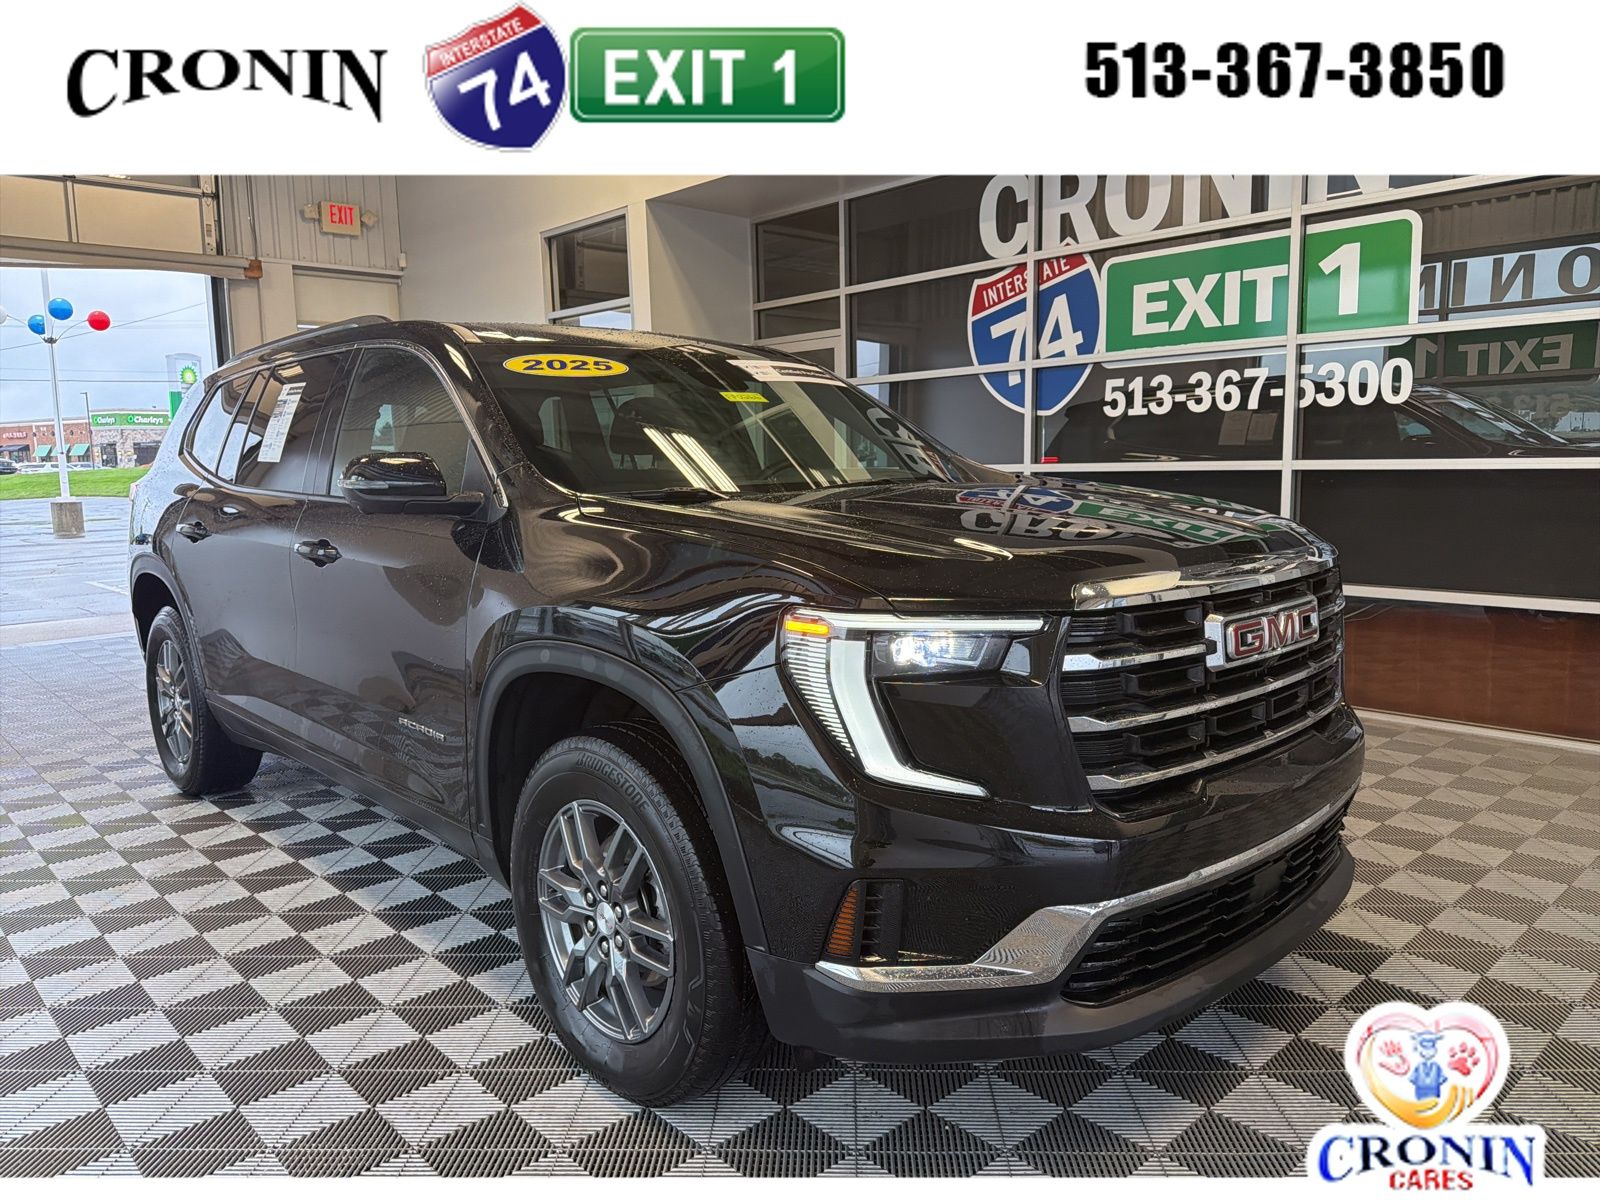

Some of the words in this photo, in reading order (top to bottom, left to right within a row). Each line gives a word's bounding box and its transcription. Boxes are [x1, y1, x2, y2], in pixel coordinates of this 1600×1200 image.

[328, 203, 354, 226] EXIT
[1131, 263, 1289, 337] EXIT
[1317, 241, 1362, 317] 1
[521, 359, 614, 372] 2025
[988, 292, 1085, 388] 74
[1227, 602, 1319, 660] GMC
[398, 716, 445, 743] ACADIA
[575, 752, 651, 811] BRIDGESTONE
